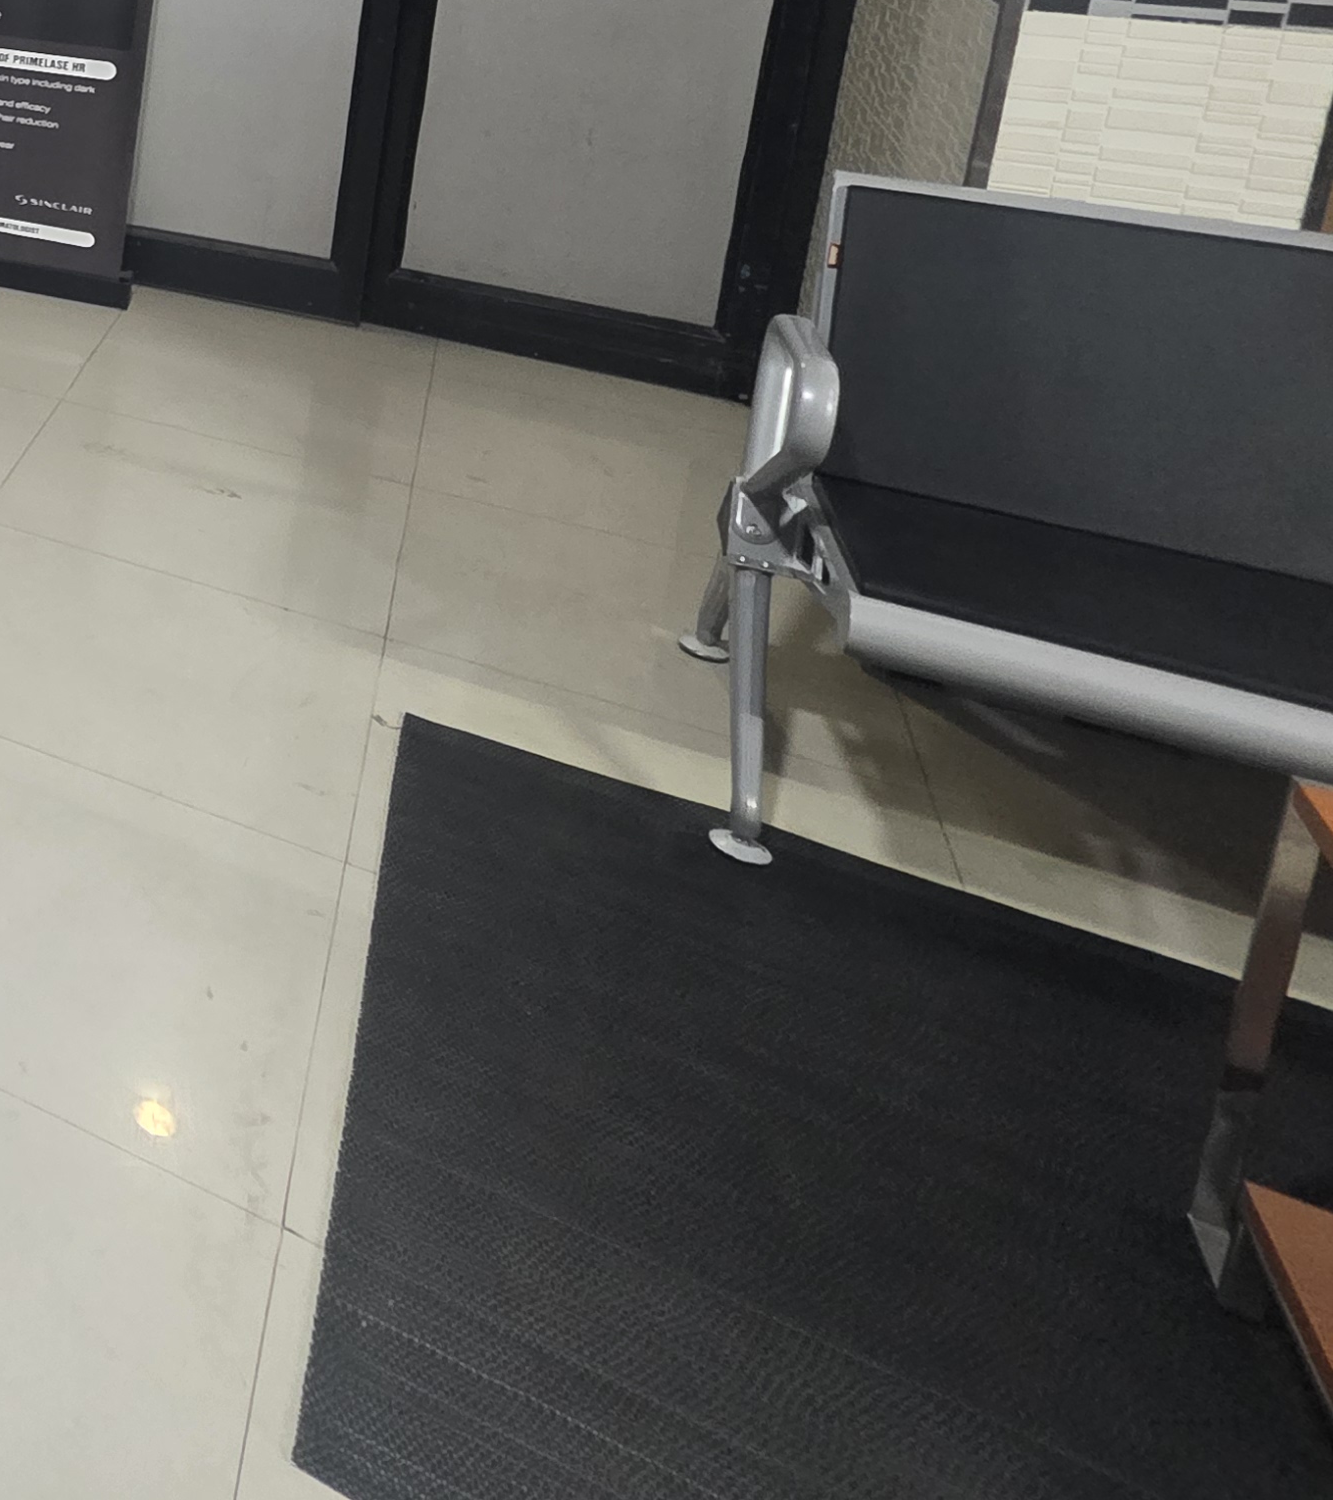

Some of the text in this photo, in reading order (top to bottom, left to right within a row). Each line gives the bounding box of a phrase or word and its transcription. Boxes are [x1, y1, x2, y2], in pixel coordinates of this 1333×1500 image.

[12, 55, 69, 71] PRIMELASE
[71, 61, 86, 73] HR
[10, 74, 31, 87] type
[31, 77, 73, 93] including
[74, 83, 96, 94] dark
[15, 100, 52, 116] efficacy
[15, 116, 60, 130] reduction
[30, 198, 93, 215] SINCLAIR
